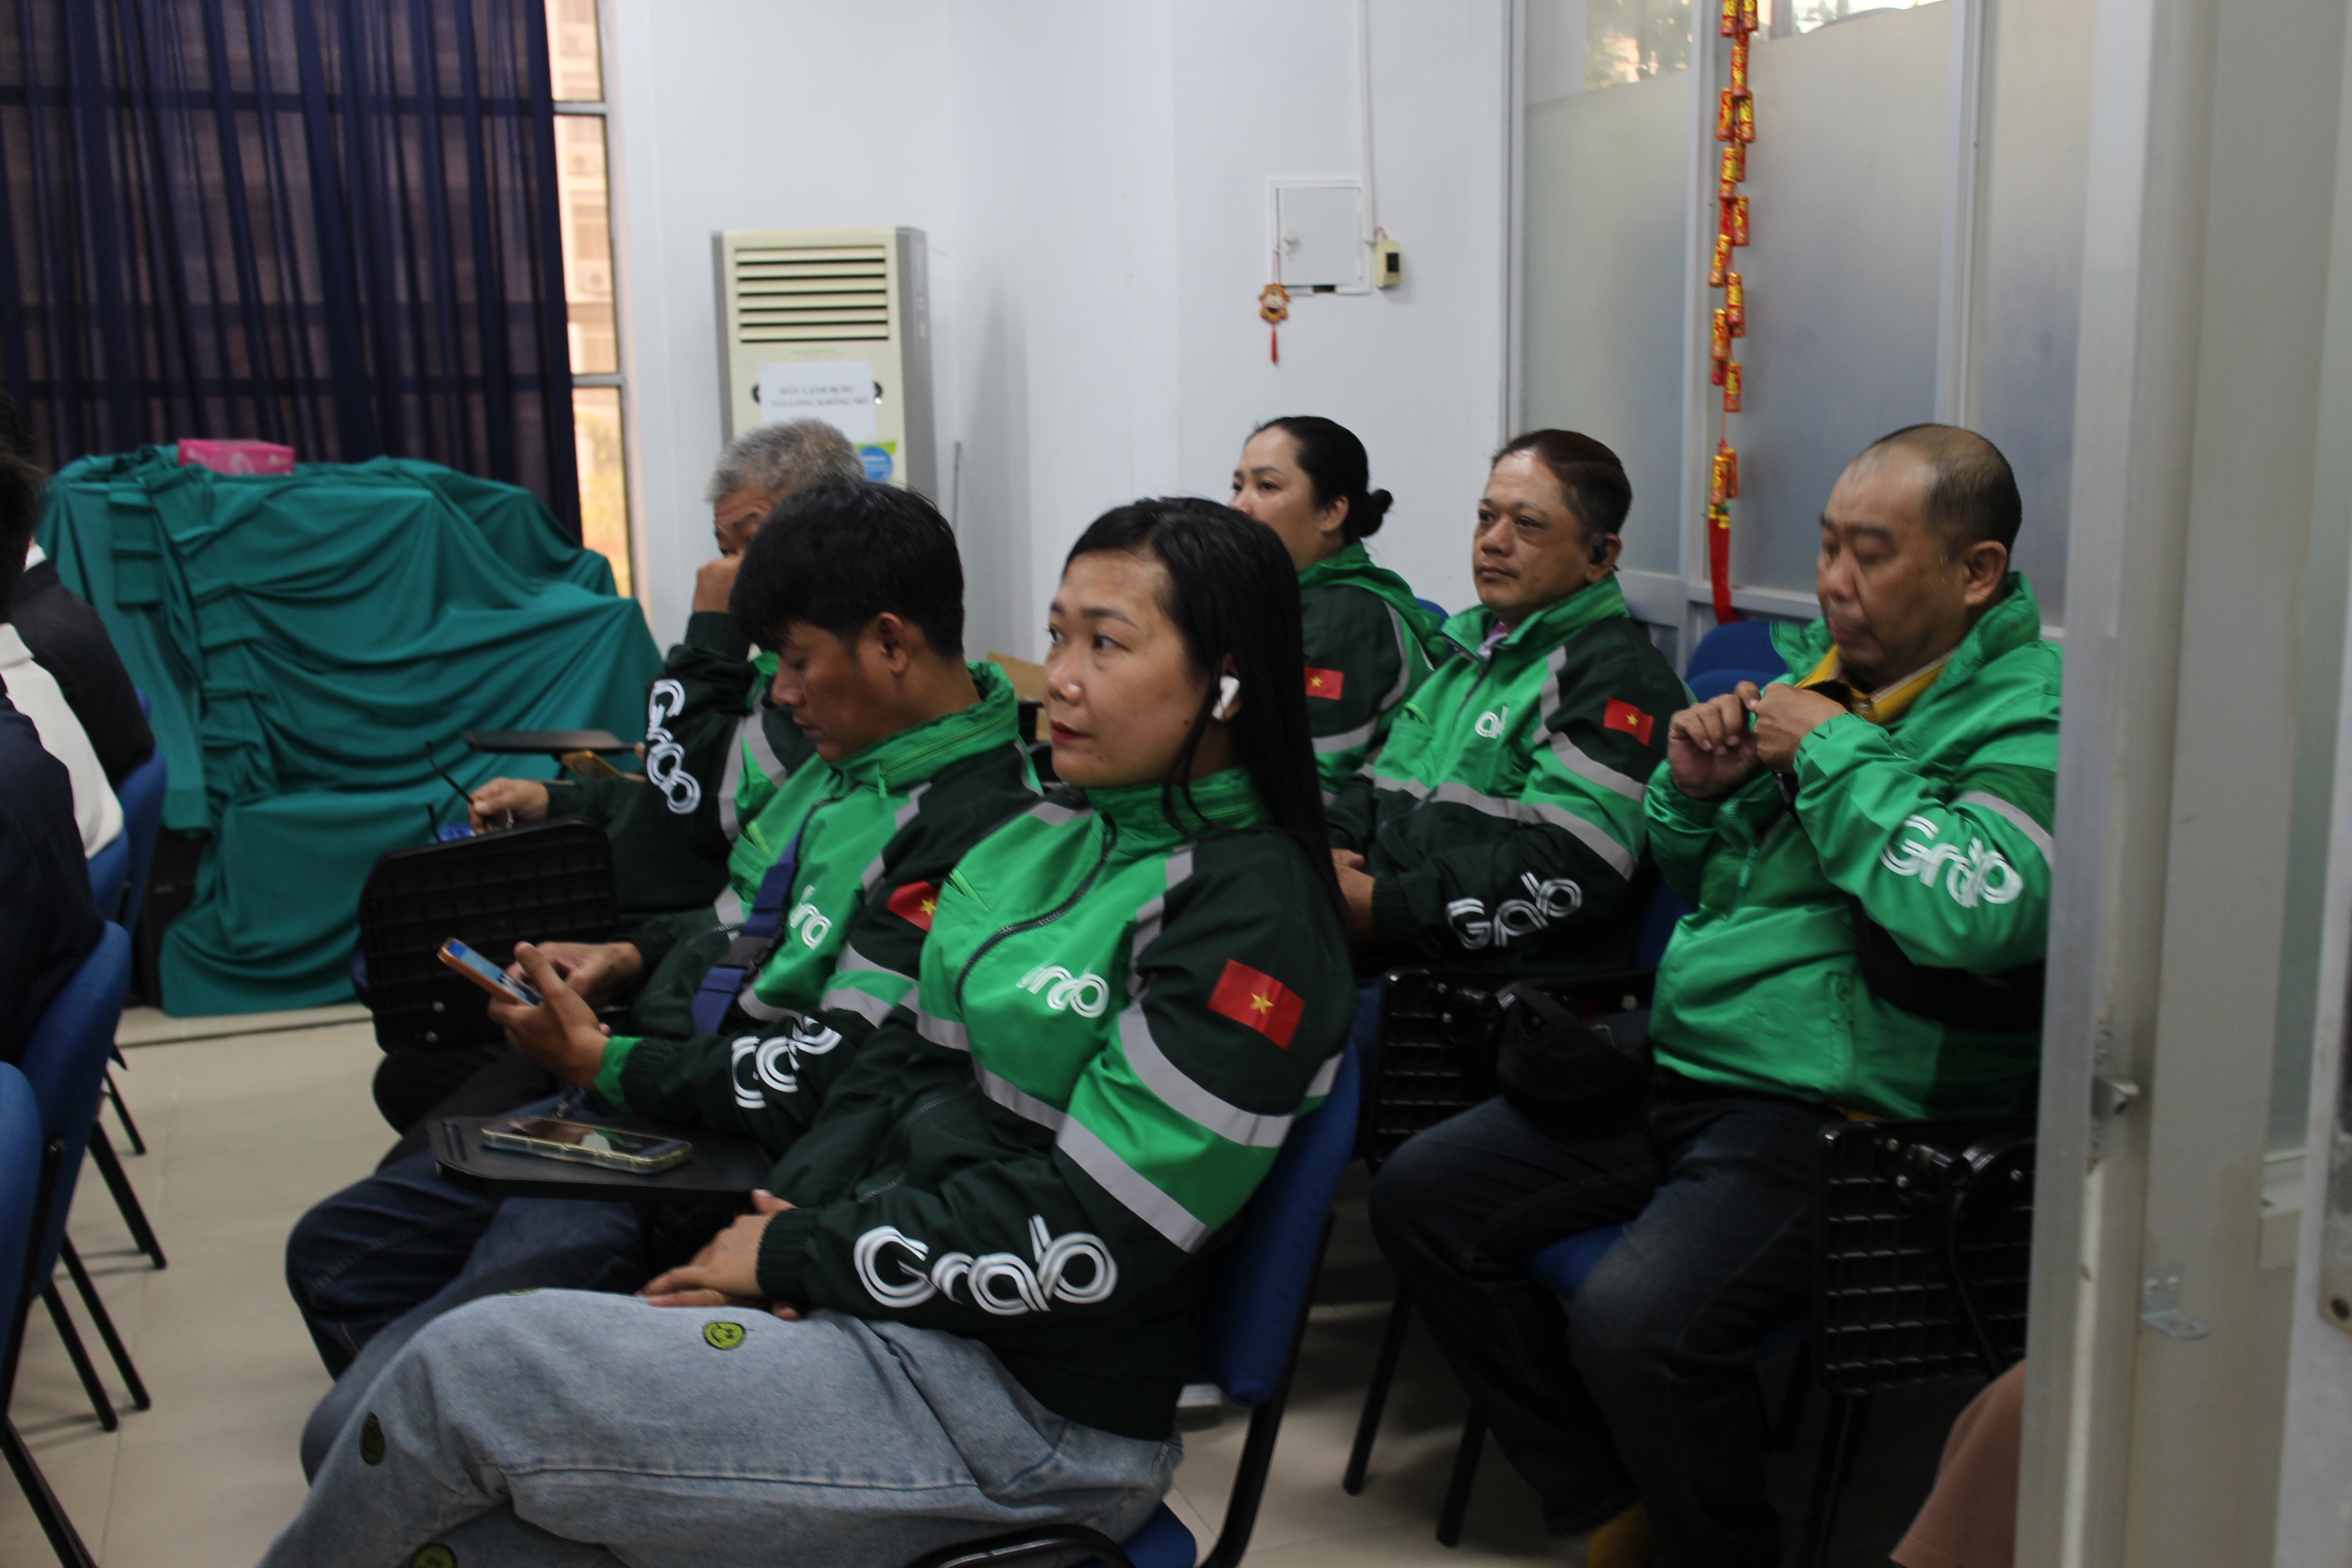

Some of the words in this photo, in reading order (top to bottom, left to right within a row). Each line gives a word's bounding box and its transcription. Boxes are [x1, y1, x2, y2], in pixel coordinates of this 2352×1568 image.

[1880, 814, 2023, 908] Grab
[1015, 961, 1110, 1019] rab
[854, 1213, 1118, 1315] Grab
